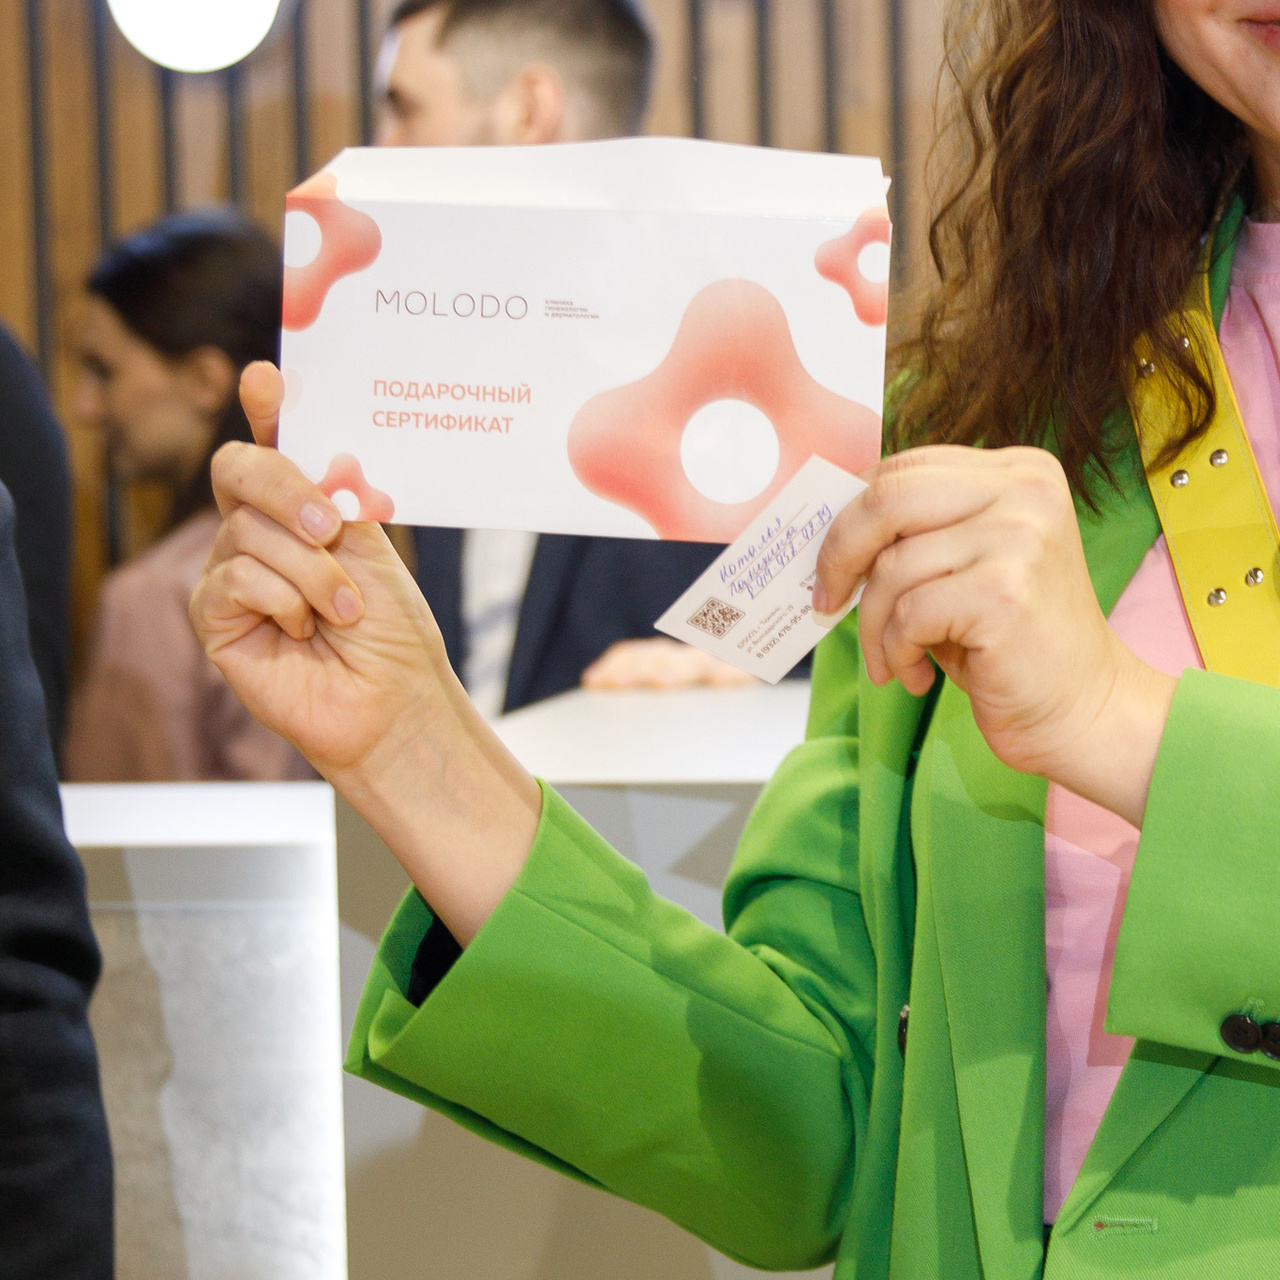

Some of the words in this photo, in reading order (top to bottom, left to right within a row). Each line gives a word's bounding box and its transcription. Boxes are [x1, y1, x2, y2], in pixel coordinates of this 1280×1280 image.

[375, 289, 529, 320] MOLODO
[373, 380, 532, 404] ПОДАРОЧНЫЙ
[372, 410, 514, 434] СЕРТИФИКАТ
